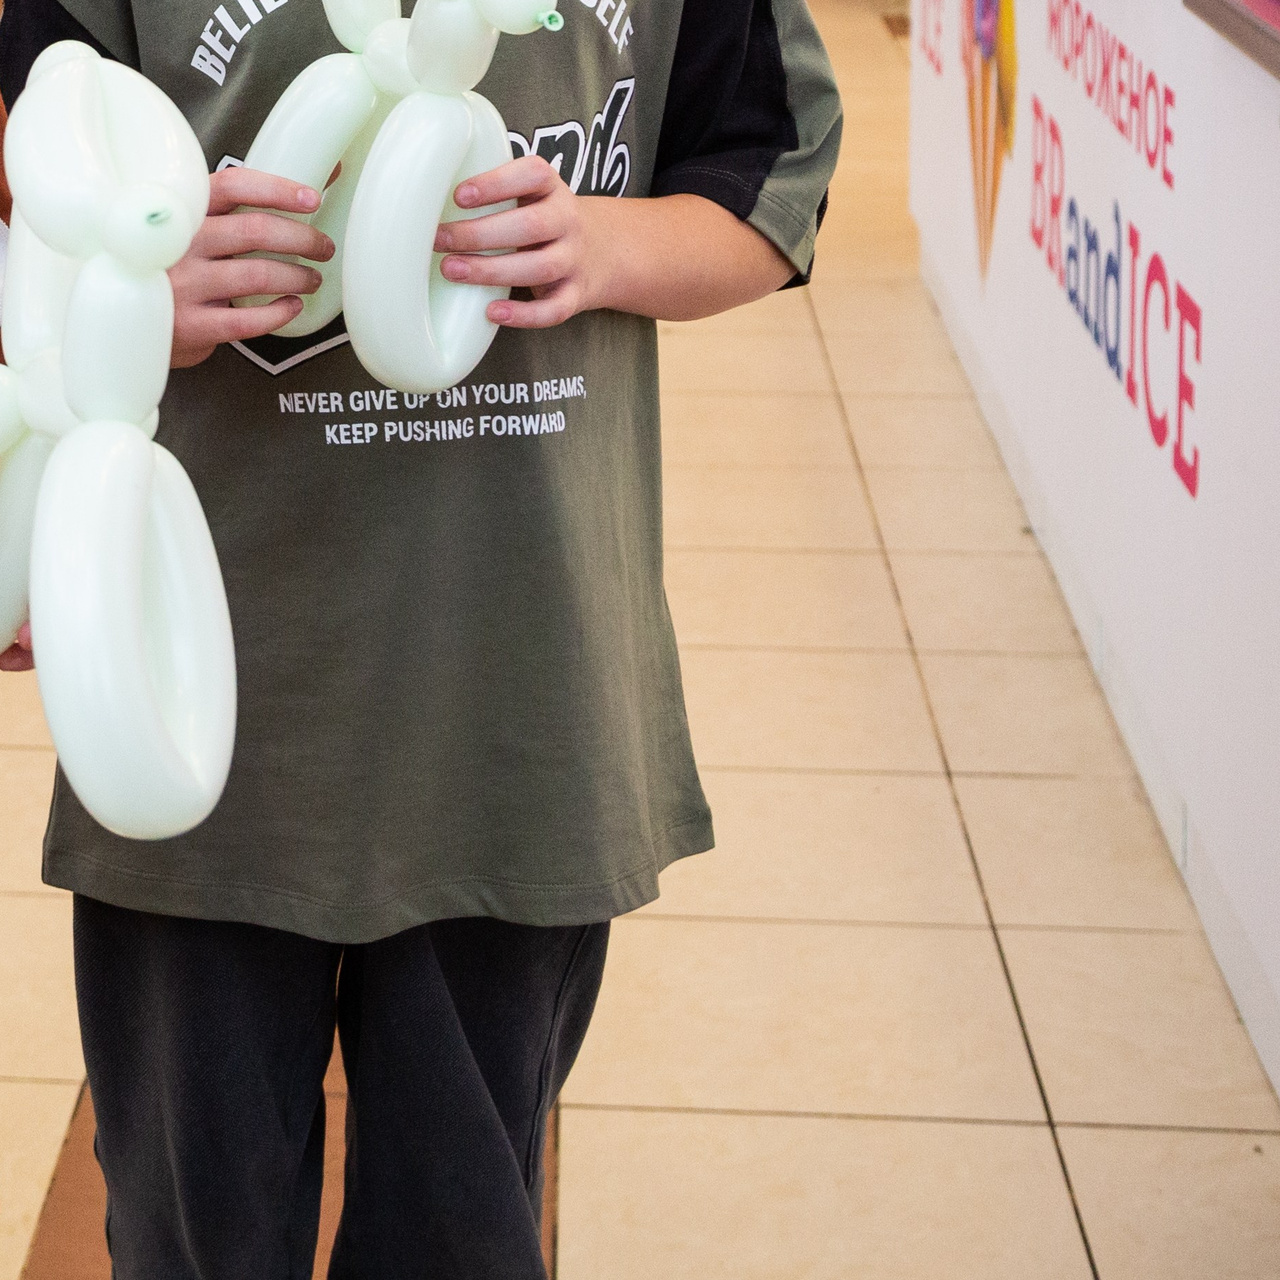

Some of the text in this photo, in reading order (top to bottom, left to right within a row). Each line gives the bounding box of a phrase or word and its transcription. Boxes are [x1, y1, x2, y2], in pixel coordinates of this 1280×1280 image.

[278, 375, 587, 413] NEVER GIVE UP ON YOUR DREAMS,
[325, 410, 566, 445] KEEP PUSHING FORWARD
